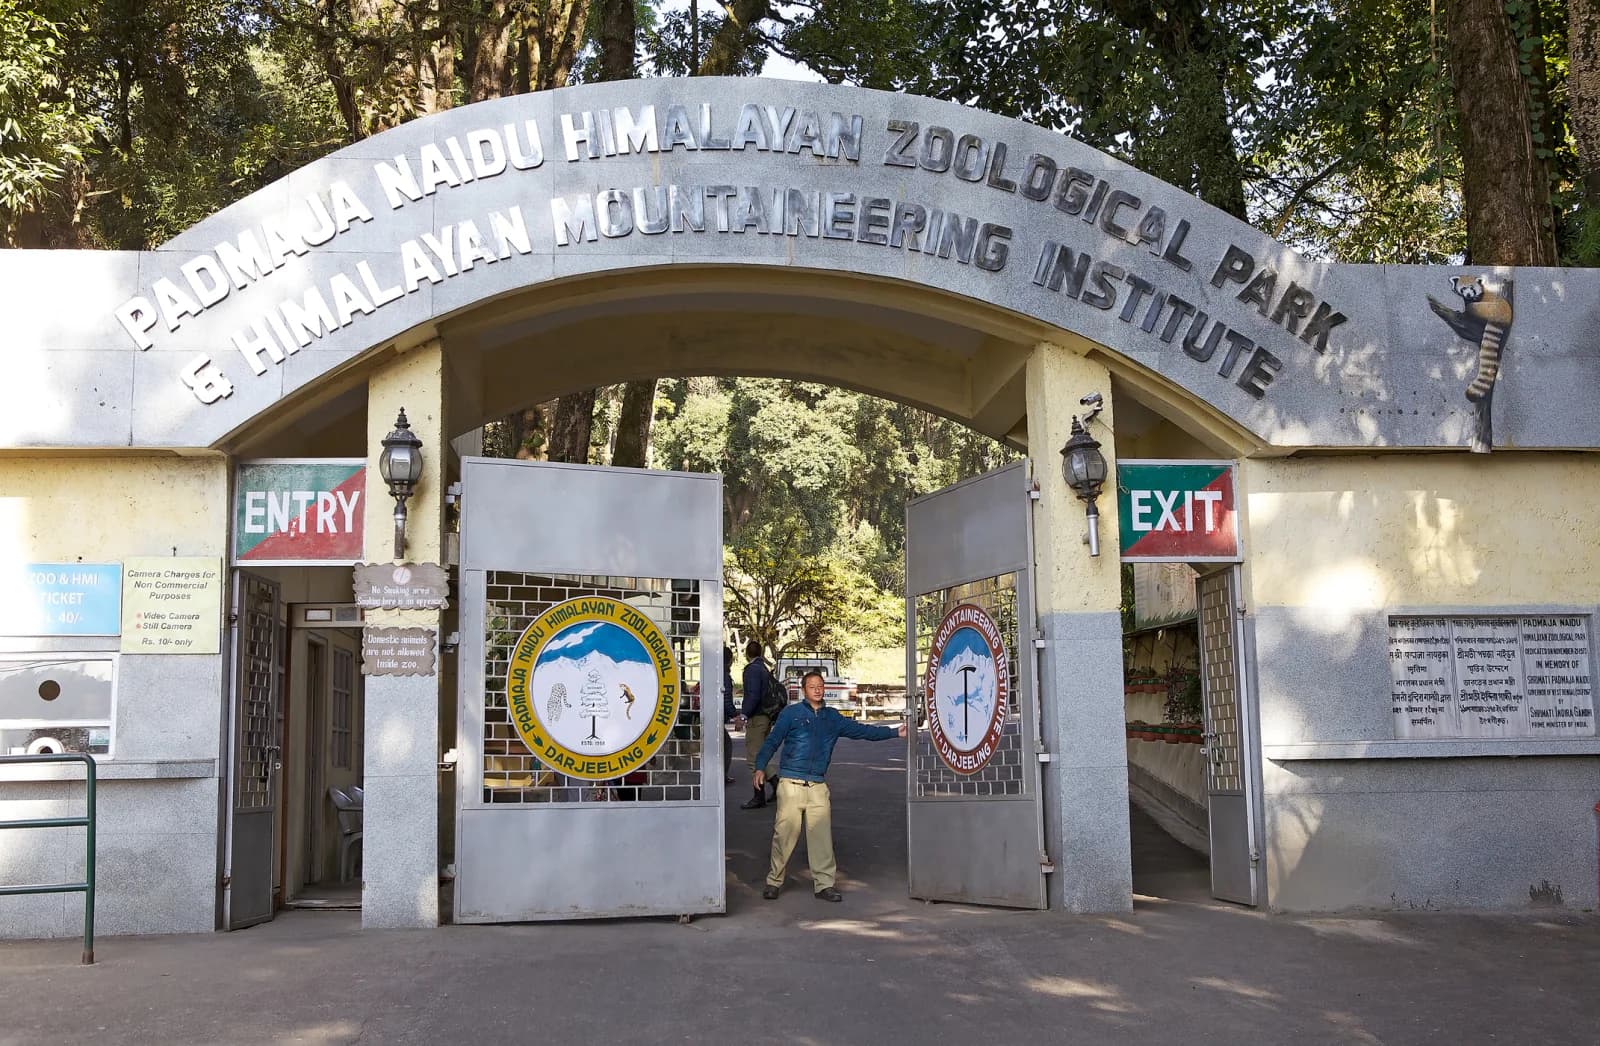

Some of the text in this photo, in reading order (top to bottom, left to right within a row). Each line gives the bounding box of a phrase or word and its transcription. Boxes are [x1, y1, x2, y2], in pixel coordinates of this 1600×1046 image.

[114, 103, 1348, 354] PADMAJA NAIDU HIMALAYAN ZOOLOGICAL PARK
[179, 184, 1283, 405] & HIMALAYAN MOUNTAINEERING INSTITUTE
[245, 490, 361, 534] ENTRY
[1130, 490, 1222, 533] EXIT
[59, 572, 69, 585] &
[72, 572, 98, 585] HMI
[127, 569, 216, 580] Camera Charges for
[134, 581, 208, 589] Non Commercial
[371, 586, 380, 594] No
[384, 585, 410, 597] Smoking
[40, 592, 84, 605] TICKET
[149, 591, 191, 601] Purposes
[143, 612, 200, 620] Video Camera
[142, 622, 192, 630] Still Camera
[1523, 619, 1557, 627] PADMAJA
[1559, 619, 1581, 627] NAIDU
[141, 638, 193, 647] Rs. 10/- only
[368, 634, 427, 644] Domestic animals
[381, 648, 395, 656] not
[397, 648, 425, 656] allowed
[512, 601, 675, 733] PADMAJA NAIDU HIMALAYAN ZOOLOGICAL PARK
[1536, 660, 1579, 668] IN MEMORY OF
[927, 608, 1007, 740] HIMALAYAN MOUNTAINEERING INSTITUTE
[544, 746, 643, 774] DARJEELING
[941, 742, 991, 770] DARJEELING
